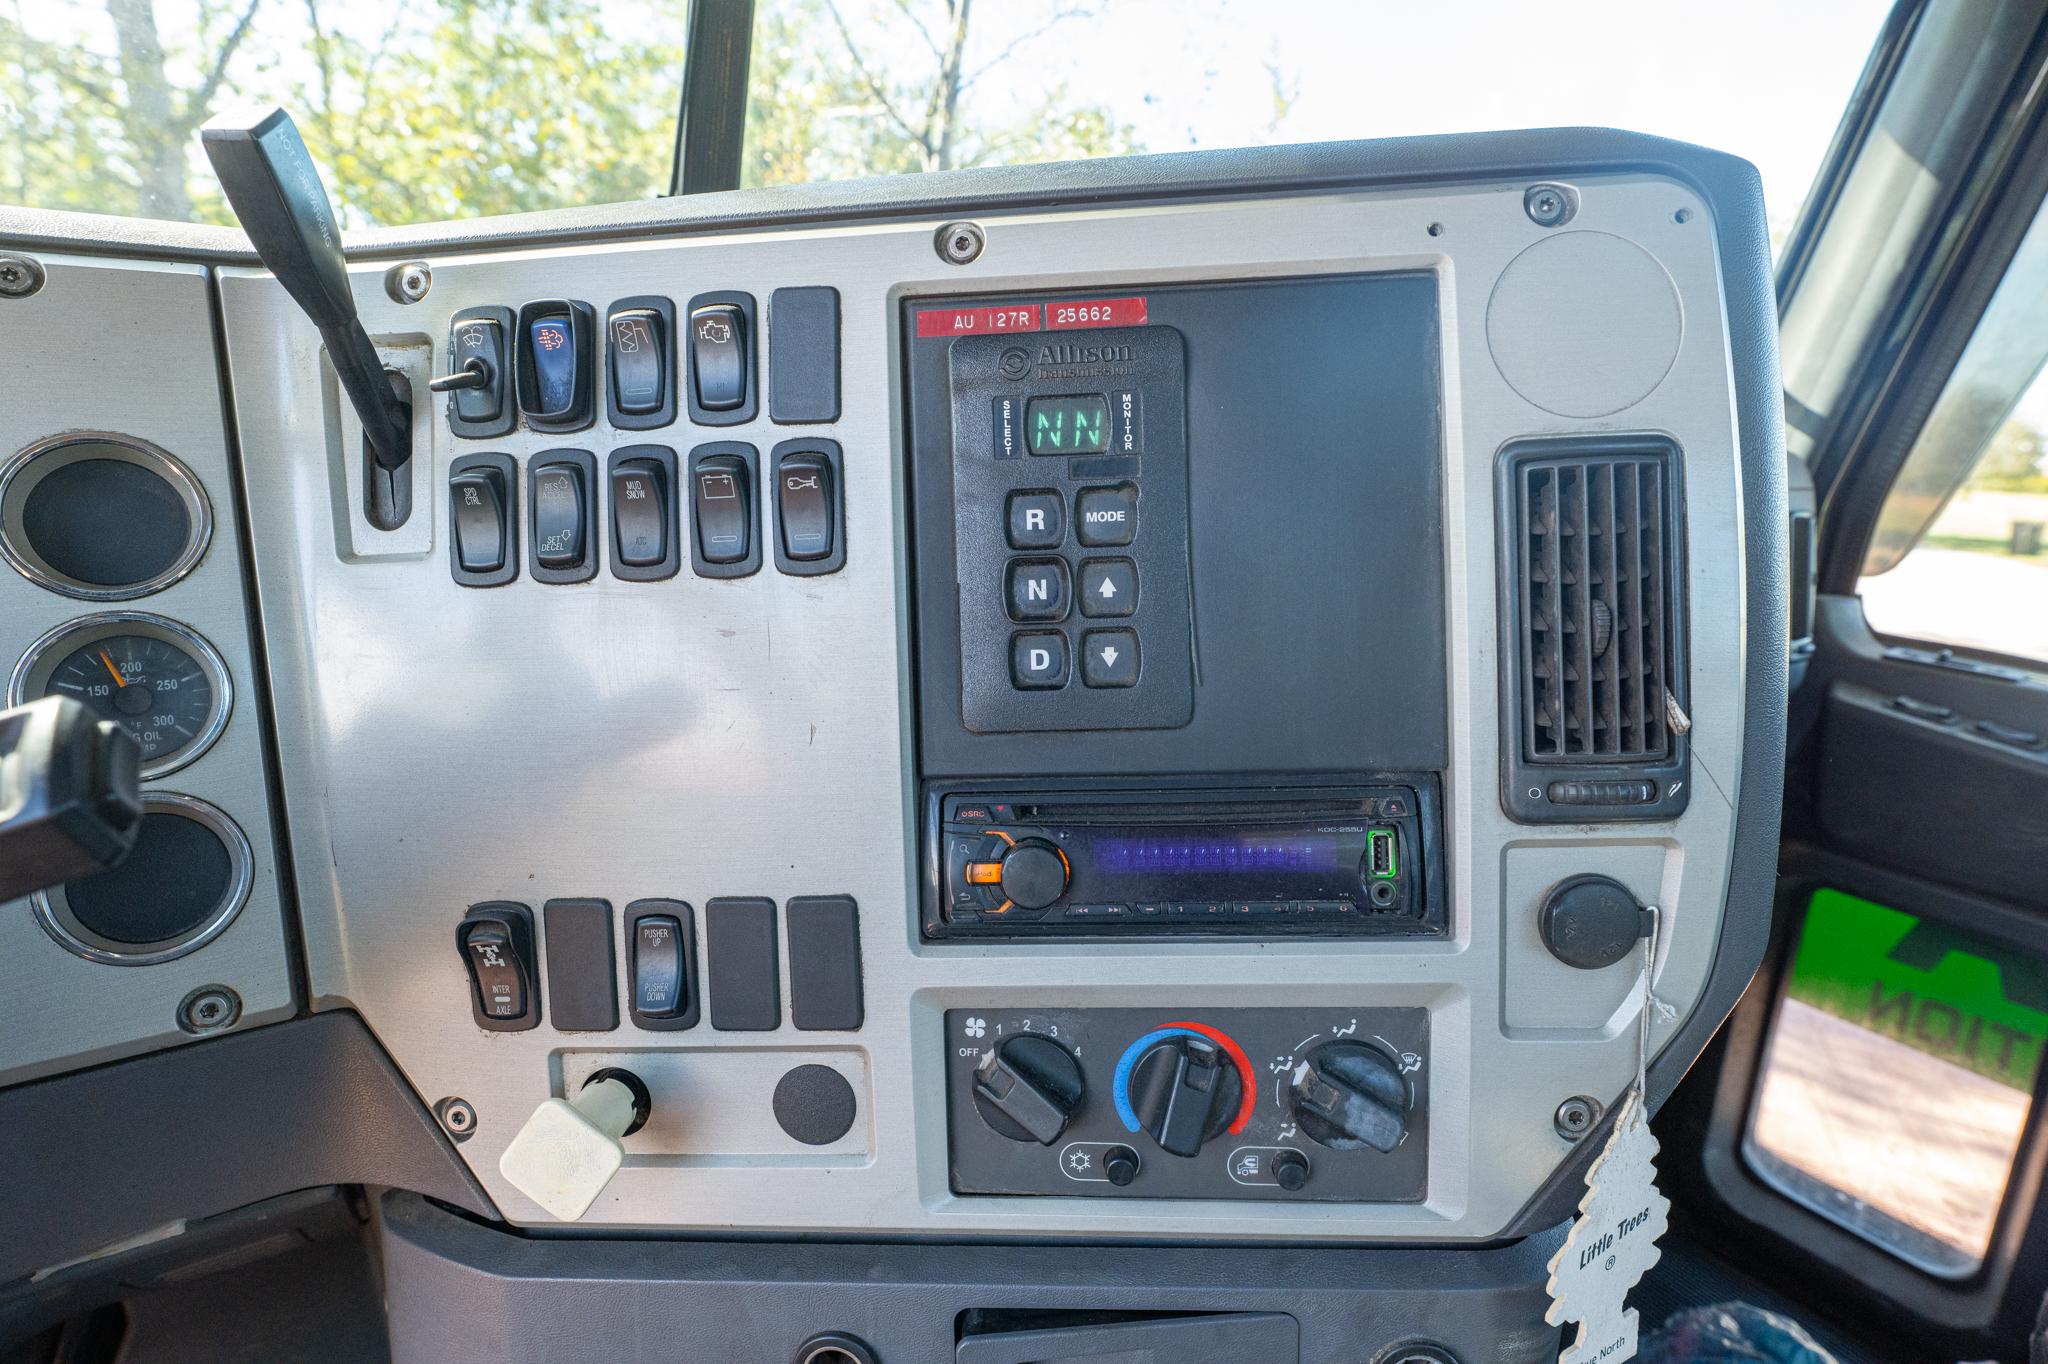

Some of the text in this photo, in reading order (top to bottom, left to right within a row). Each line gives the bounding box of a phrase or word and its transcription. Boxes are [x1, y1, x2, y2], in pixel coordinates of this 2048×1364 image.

[277, 128, 332, 248] NOT FOR PARKING
[1057, 306, 1112, 323] 25662
[954, 314, 974, 329] AU
[1036, 344, 1134, 365] Allison
[1122, 393, 1133, 450] MONITOR
[1002, 400, 1011, 456] SELECT
[625, 480, 642, 490] MUD
[463, 487, 477, 497] SPD
[626, 490, 646, 500] SNOW
[465, 496, 482, 505] CTRL
[1025, 509, 1045, 531] R
[1086, 511, 1126, 522] MODE
[547, 535, 561, 544] SET
[541, 543, 564, 552] DECEL
[1028, 579, 1048, 600] N
[1030, 649, 1050, 671] D
[120, 662, 142, 673] 200
[87, 685, 109, 697] 150
[156, 679, 178, 692] 250
[152, 714, 175, 727] 300
[143, 730, 164, 742] OIL
[966, 810, 985, 818] SRC
[644, 928, 669, 939] PUSHER
[652, 938, 662, 947] UP
[491, 984, 511, 994] INTER
[644, 982, 669, 992] PUSHER
[646, 992, 666, 1001] DOWN
[496, 1005, 512, 1015] AXLE
[995, 1019, 1082, 1058] 1 2 3 4
[958, 1047, 980, 1057] OFF
[1579, 1207, 1650, 1270] Little Trees
[1600, 1336, 1625, 1360] North
